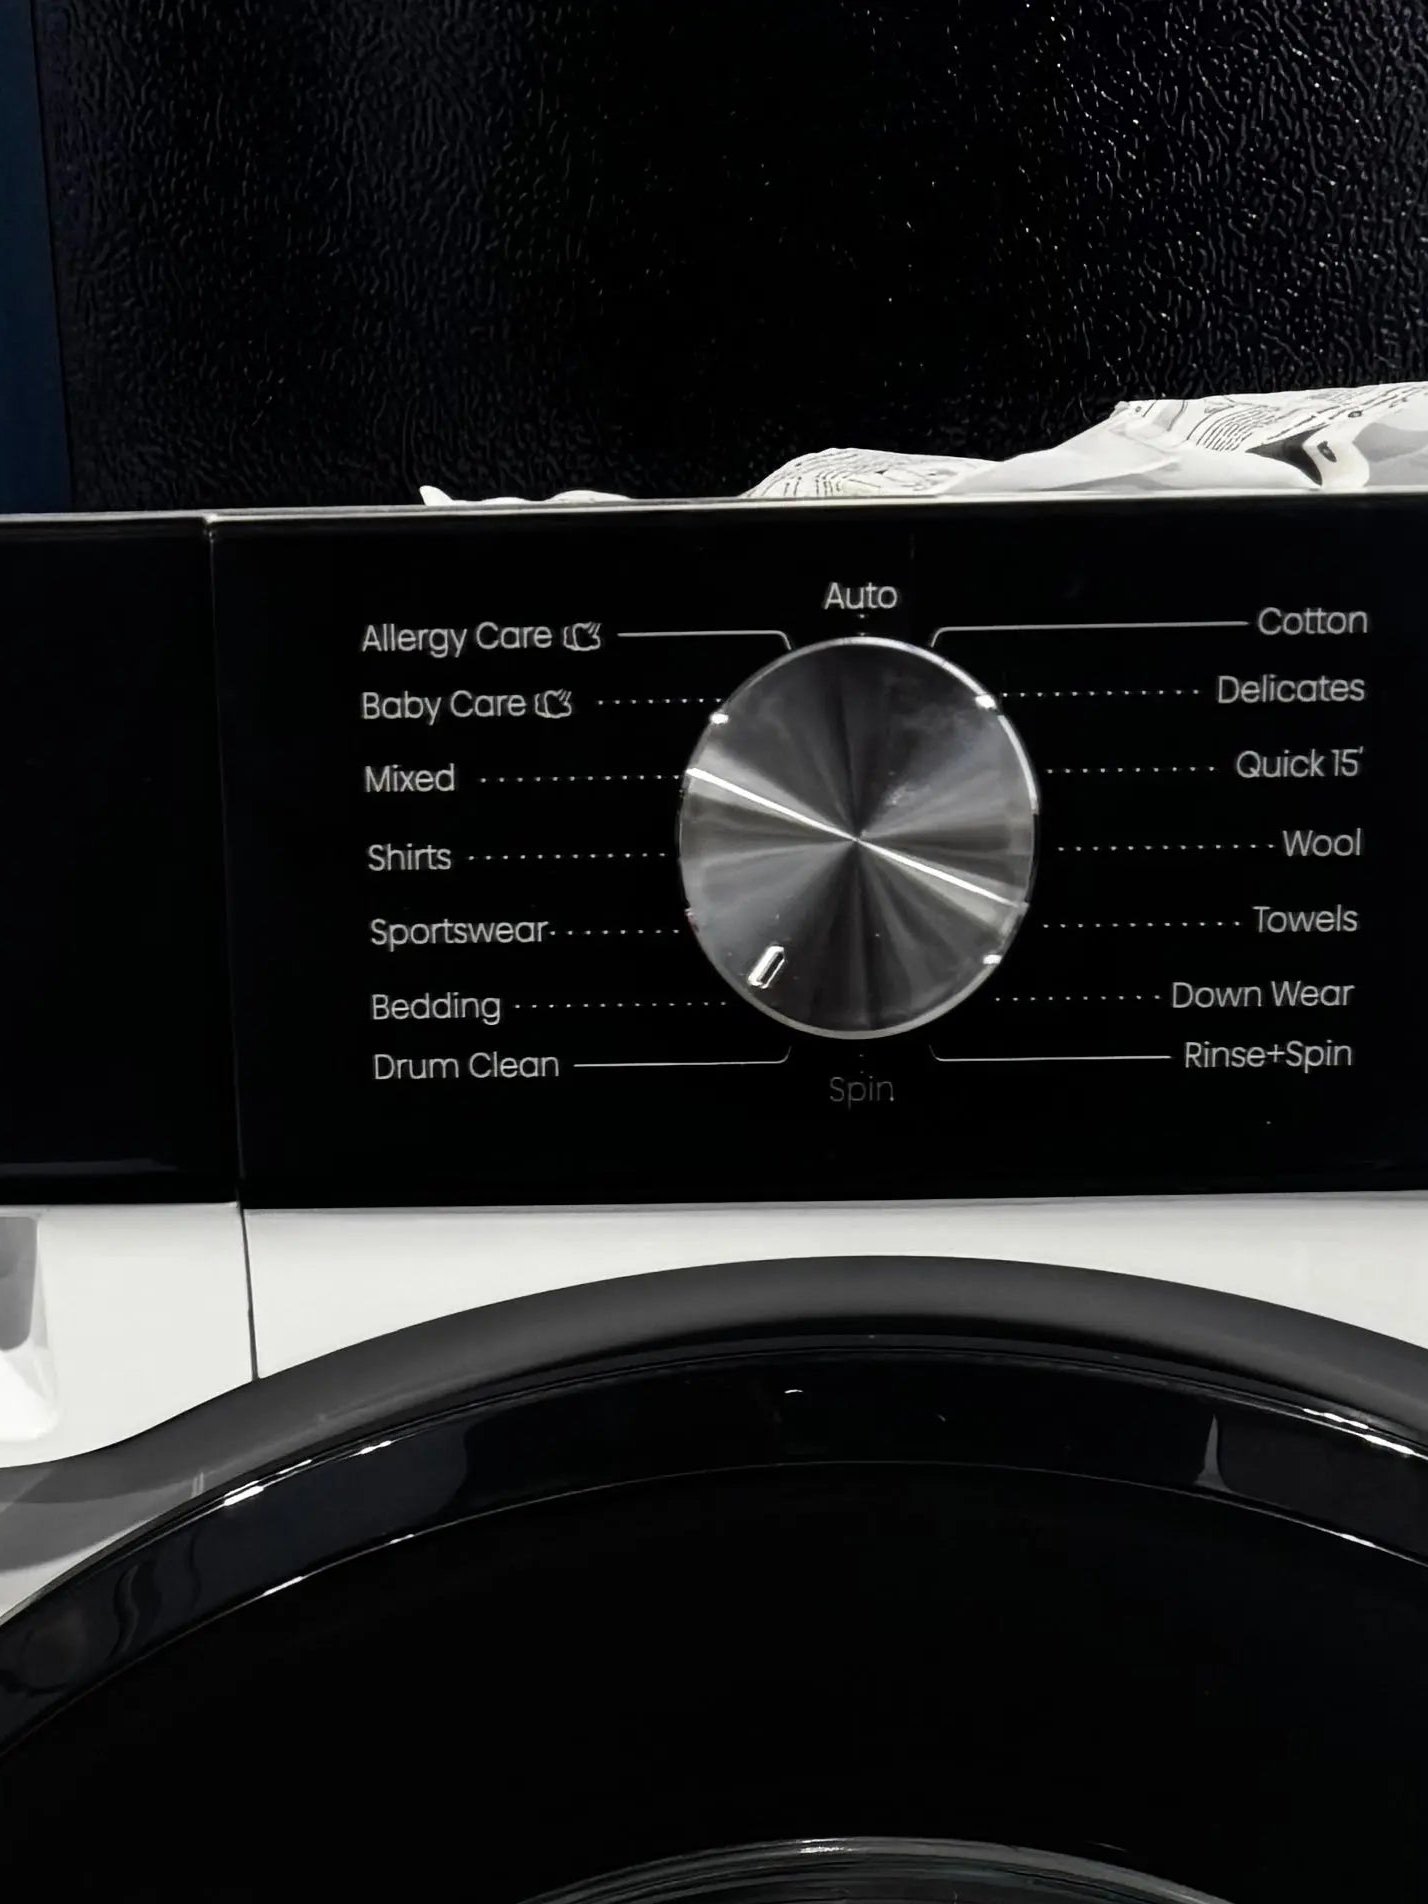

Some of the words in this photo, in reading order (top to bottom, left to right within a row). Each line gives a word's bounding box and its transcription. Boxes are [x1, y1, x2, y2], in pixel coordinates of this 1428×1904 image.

[824, 581, 898, 610] Auto
[1257, 607, 1368, 635] Cotton
[362, 624, 467, 658] Allergy
[475, 622, 553, 650] Care
[1217, 675, 1365, 703] Delicates
[362, 691, 441, 725] Baby
[450, 690, 527, 717] Care
[364, 763, 455, 793] Mixed
[1236, 749, 1324, 779] Quick
[1283, 828, 1361, 857] Wool
[368, 844, 452, 871] Shirts
[1253, 905, 1358, 933] Towels
[370, 917, 549, 952] Sportswear
[372, 992, 501, 1026] Bedding
[1172, 981, 1262, 1009] Down
[1270, 981, 1355, 1007] Wear
[374, 1053, 459, 1080] Drum
[468, 1051, 559, 1078] Clean
[1184, 1040, 1352, 1073] Rinse+Spin
[829, 1075, 895, 1108] Spin
